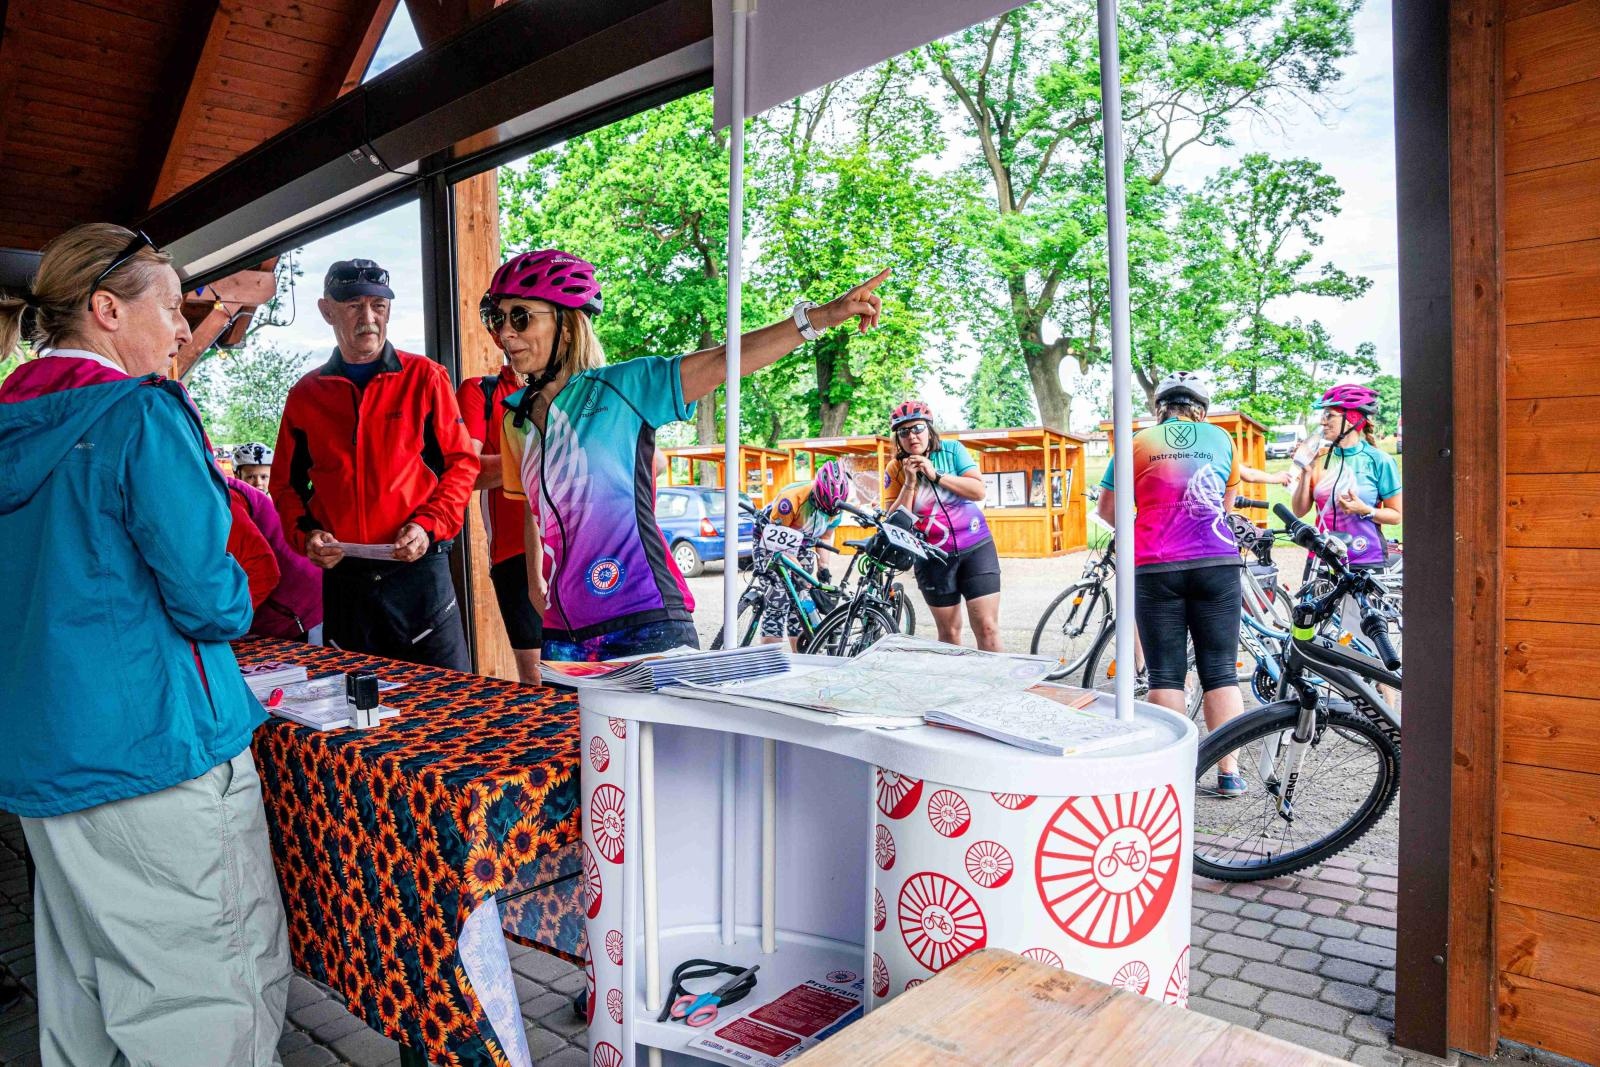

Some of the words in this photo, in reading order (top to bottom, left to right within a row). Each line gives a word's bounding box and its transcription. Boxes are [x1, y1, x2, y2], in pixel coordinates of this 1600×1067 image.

[1149, 451, 1214, 462] Jastrzębie-Zdrój
[766, 528, 799, 548] 282
[805, 979, 859, 998] Program
